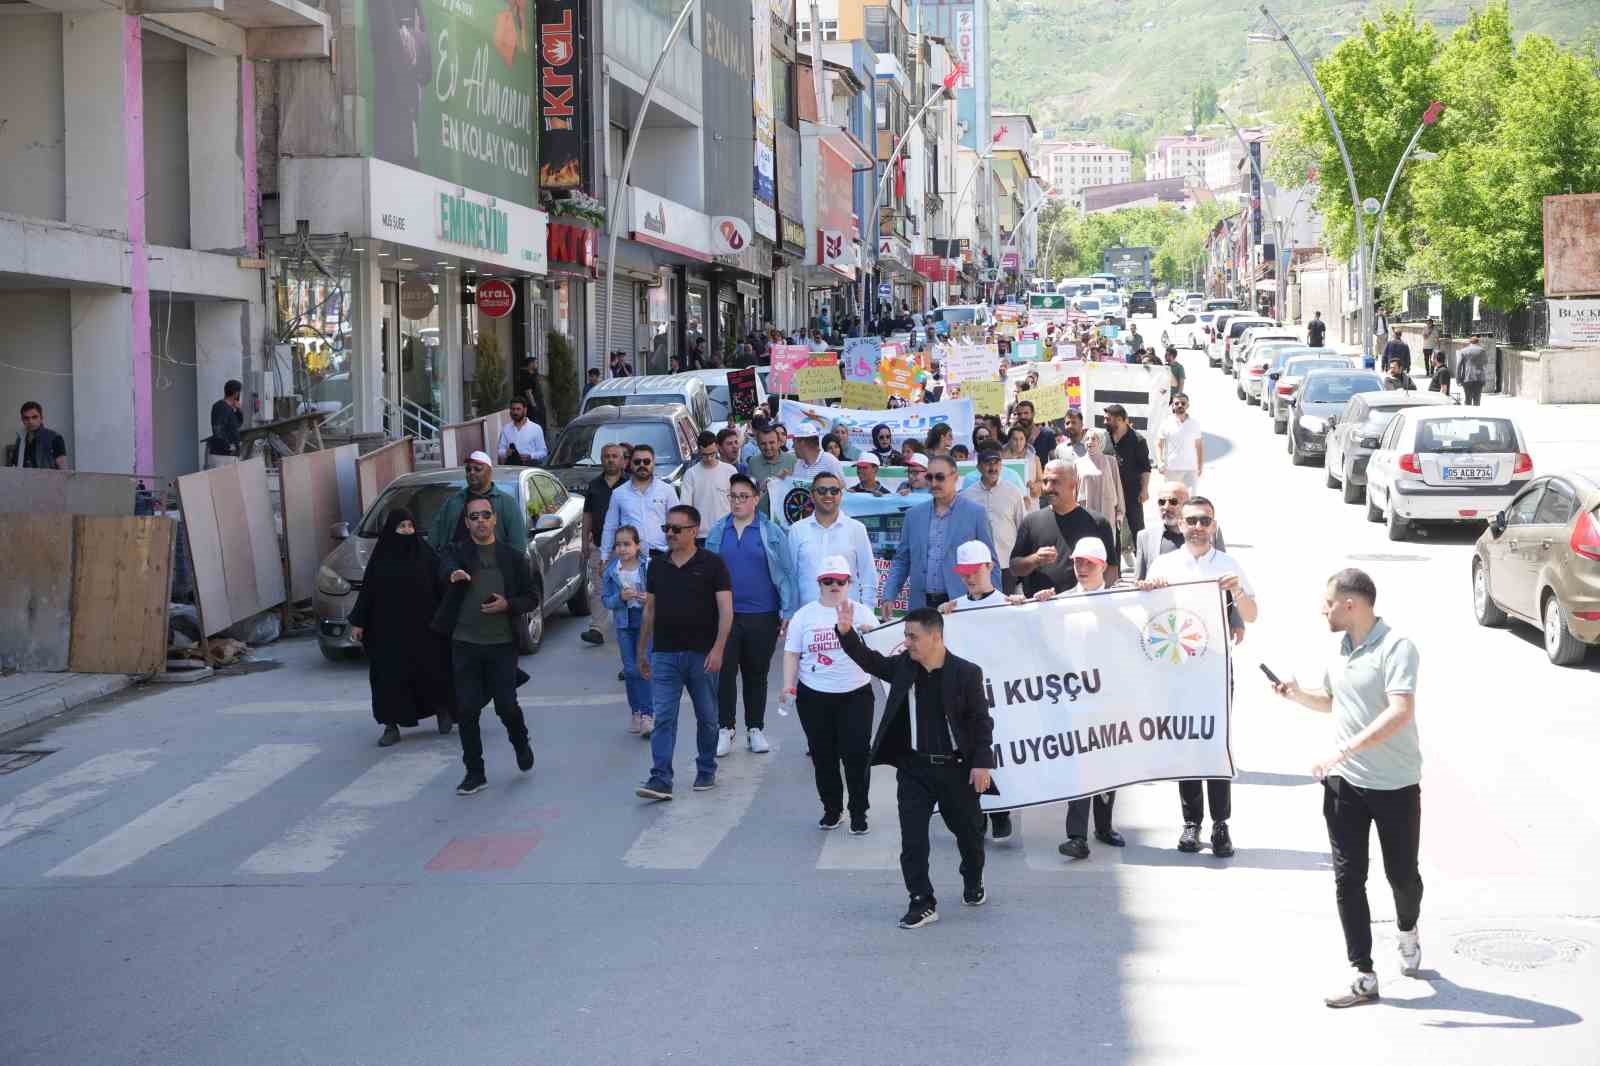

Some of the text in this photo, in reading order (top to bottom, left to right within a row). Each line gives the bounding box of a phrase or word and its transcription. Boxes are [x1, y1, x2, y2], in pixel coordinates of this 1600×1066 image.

[441, 113, 528, 176] EN KOLAY YOLU
[1449, 468, 1457, 477] 05
[1476, 468, 1491, 477] 734
[1005, 667, 1101, 705] KUŞÇU
[1010, 719, 1133, 766] UYGULAMA
[1138, 714, 1215, 743] OKULU
